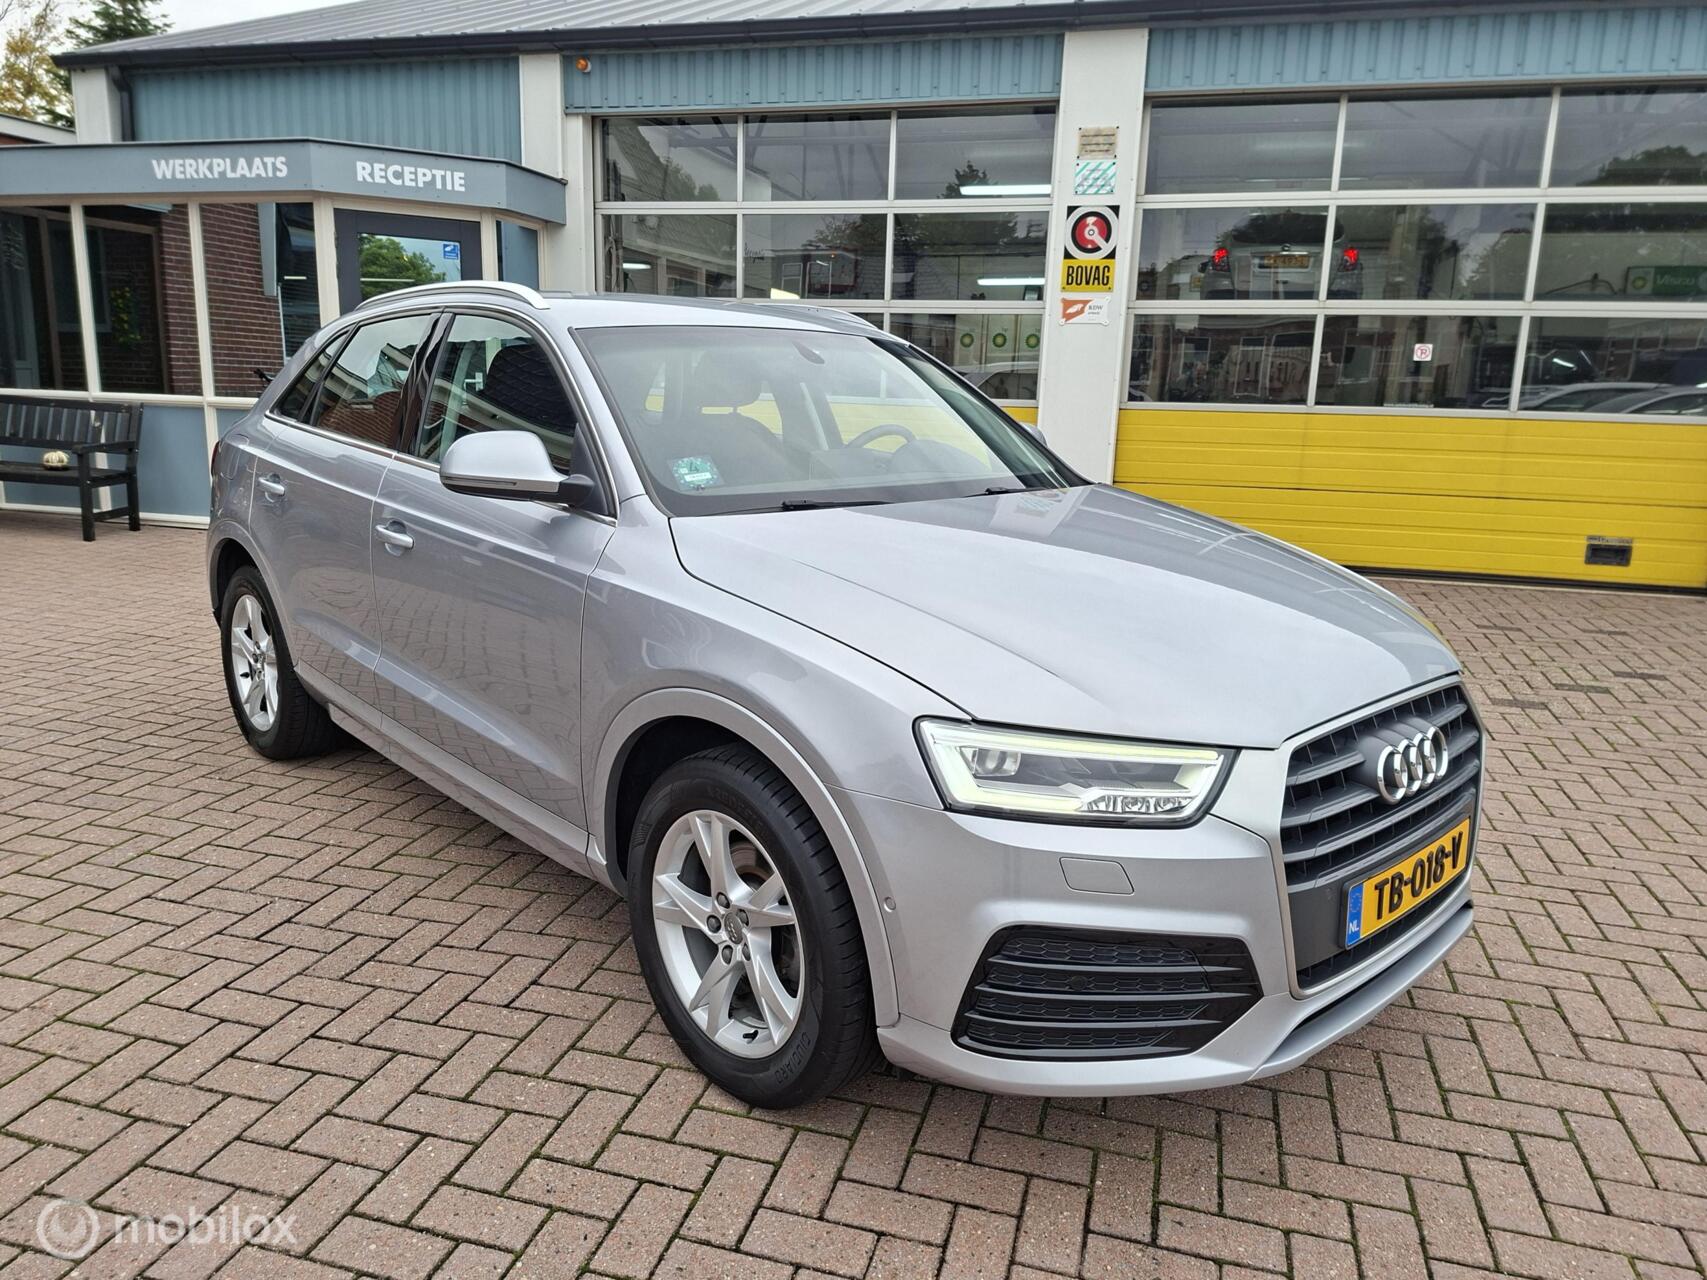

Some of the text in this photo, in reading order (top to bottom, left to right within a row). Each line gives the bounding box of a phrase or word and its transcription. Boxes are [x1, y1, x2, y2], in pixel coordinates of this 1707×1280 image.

[151, 156, 288, 180] WERKPLAATS
[356, 161, 466, 192] RECEPTIE
[1066, 265, 1111, 286] BOVAG
[1374, 831, 1464, 921] TB-018-V
[1348, 920, 1360, 935] NL
